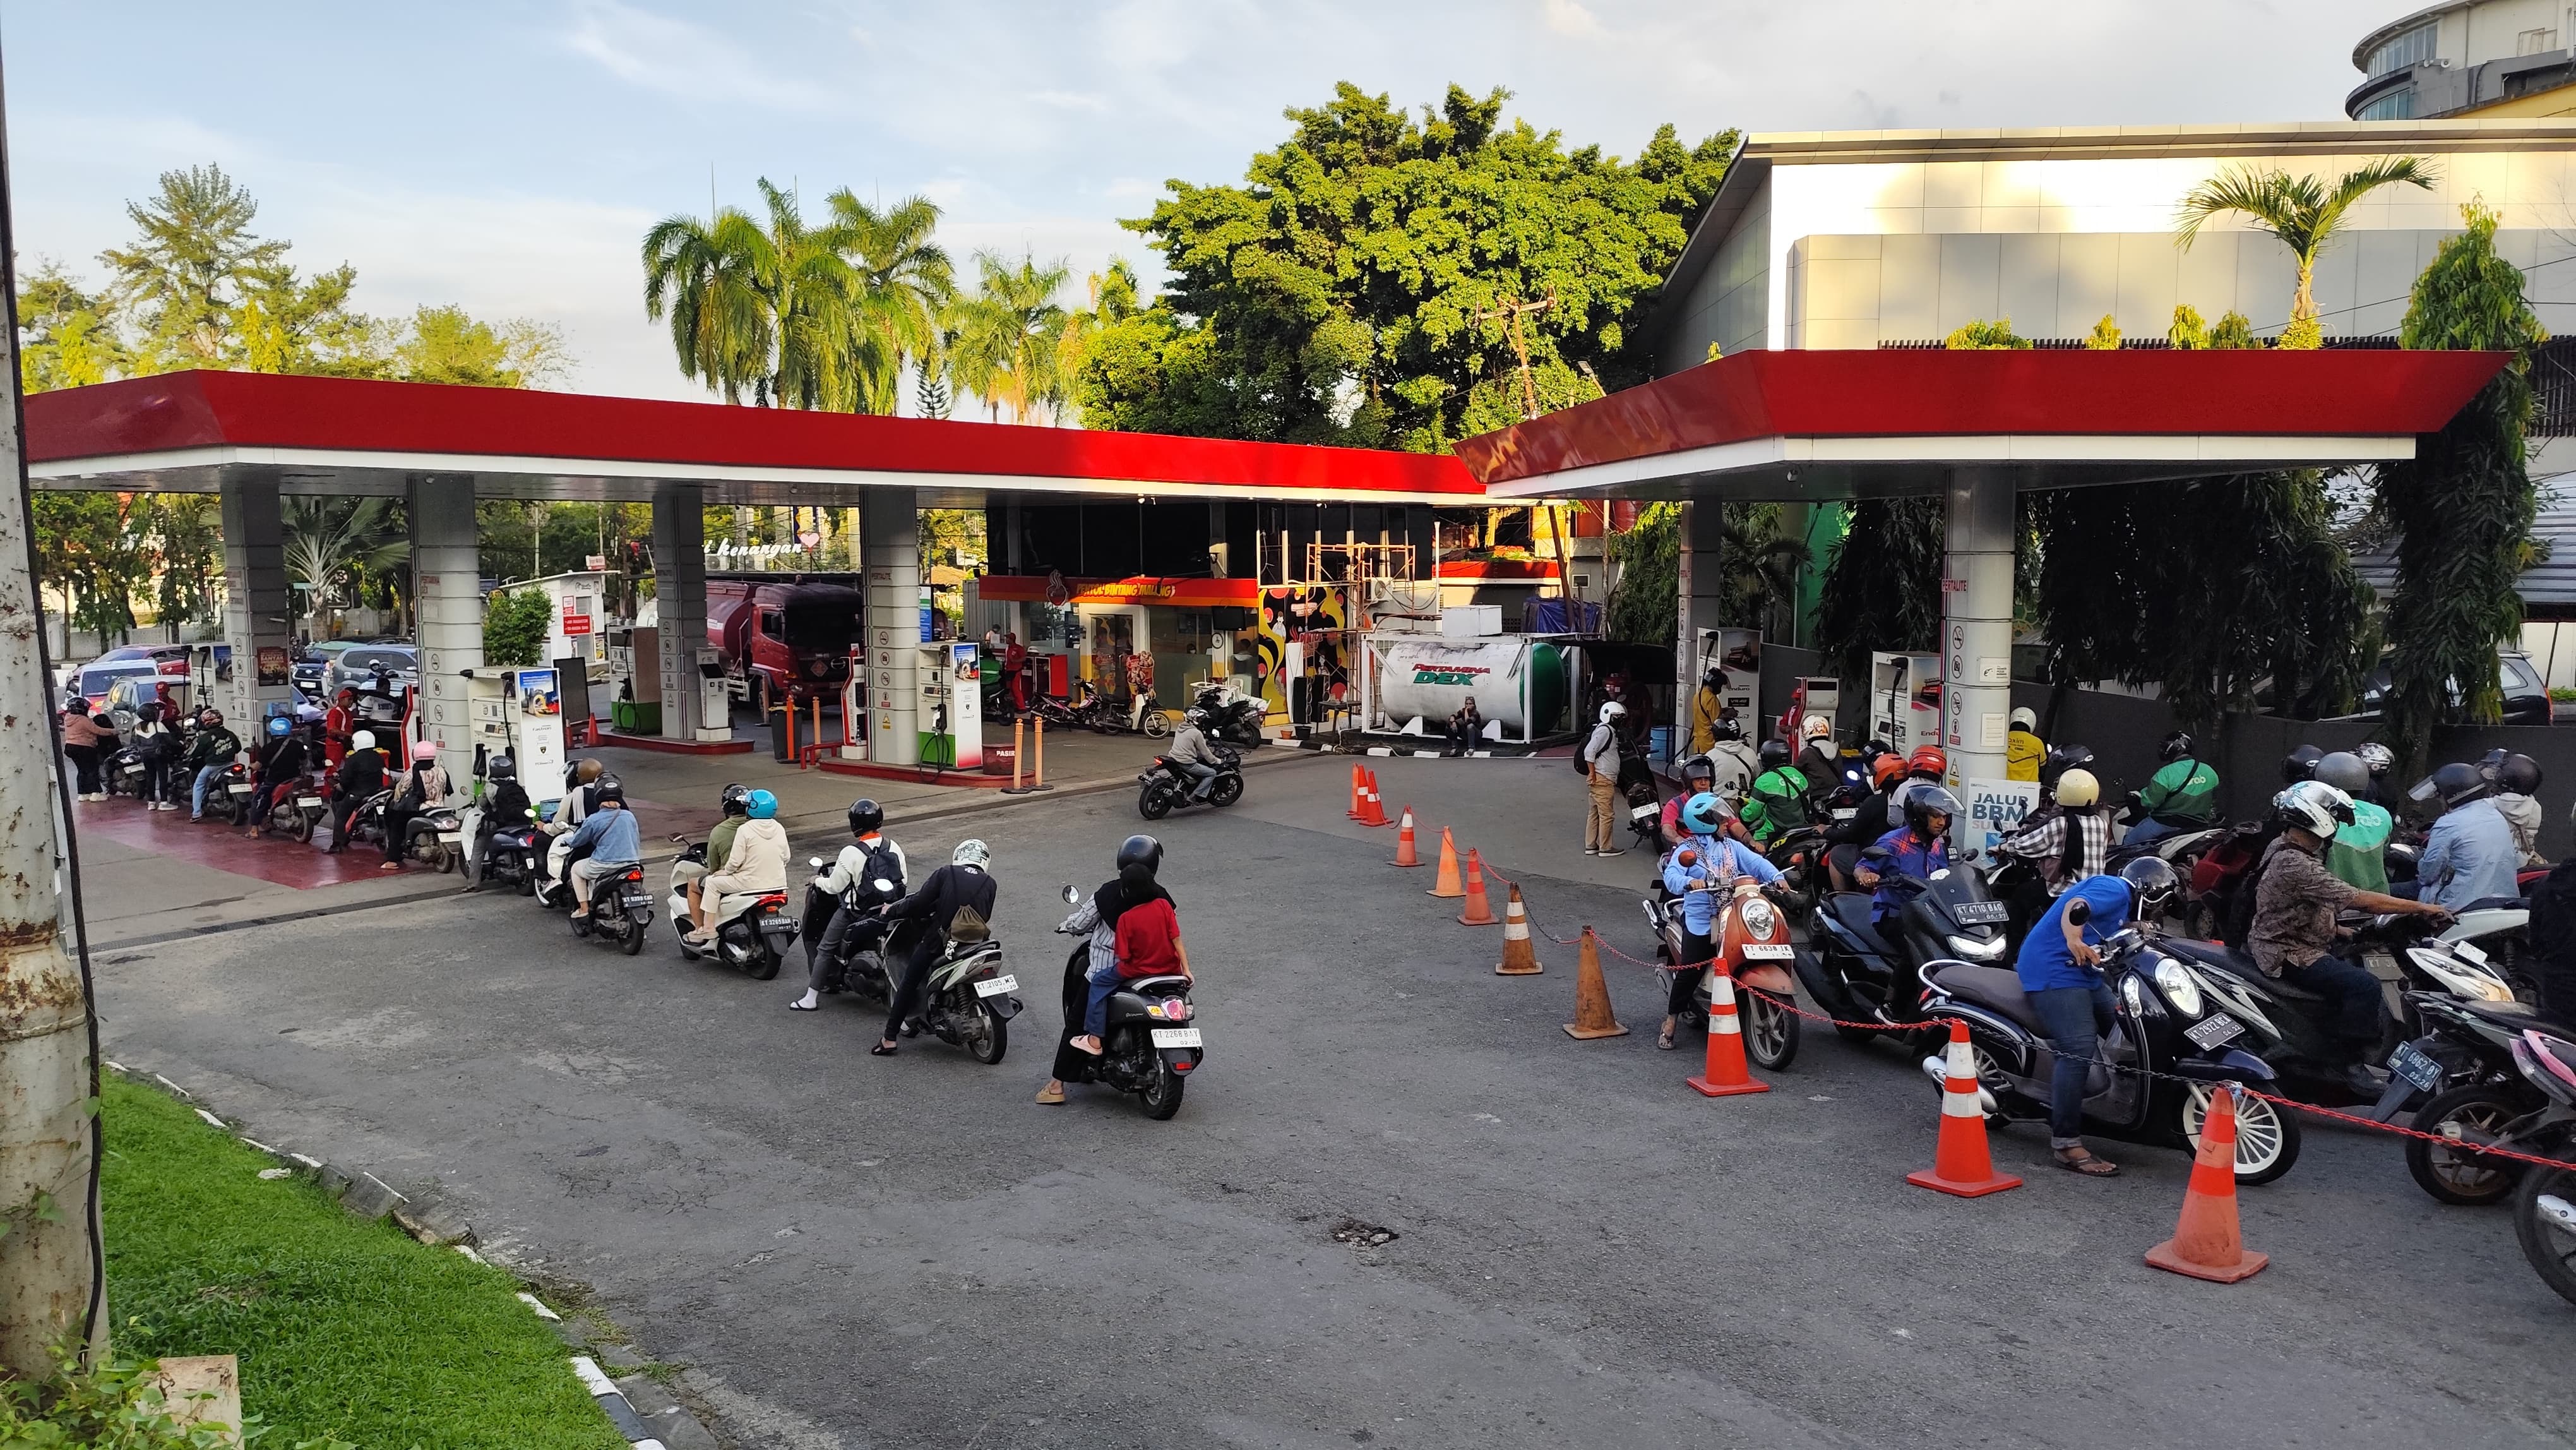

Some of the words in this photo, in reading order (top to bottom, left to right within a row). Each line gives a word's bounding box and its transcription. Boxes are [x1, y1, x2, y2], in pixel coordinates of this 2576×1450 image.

[717, 537, 802, 558] kenangan
[1076, 584, 1104, 596] PENTOL
[1106, 584, 1137, 596] BINTANG
[1942, 580, 1967, 592] PERTALITE
[1412, 663, 1491, 674] PERTAMINA
[1414, 671, 1479, 686] DEX
[1974, 793, 2029, 806] JALUR
[1972, 804, 2024, 822] BBM
[1957, 906, 1967, 914] KT
[1969, 904, 1986, 913] 4710
[987, 979, 1003, 988] 2105
[1153, 1030, 1162, 1038] KT
[1183, 1029, 1198, 1038] BAY
[2188, 1029, 2203, 1040] KT
[2198, 1021, 2221, 1035] 2922
[2214, 1015, 2233, 1026] BCA
[2396, 1043, 2409, 1057] KT
[2407, 1052, 2428, 1070] 6862
